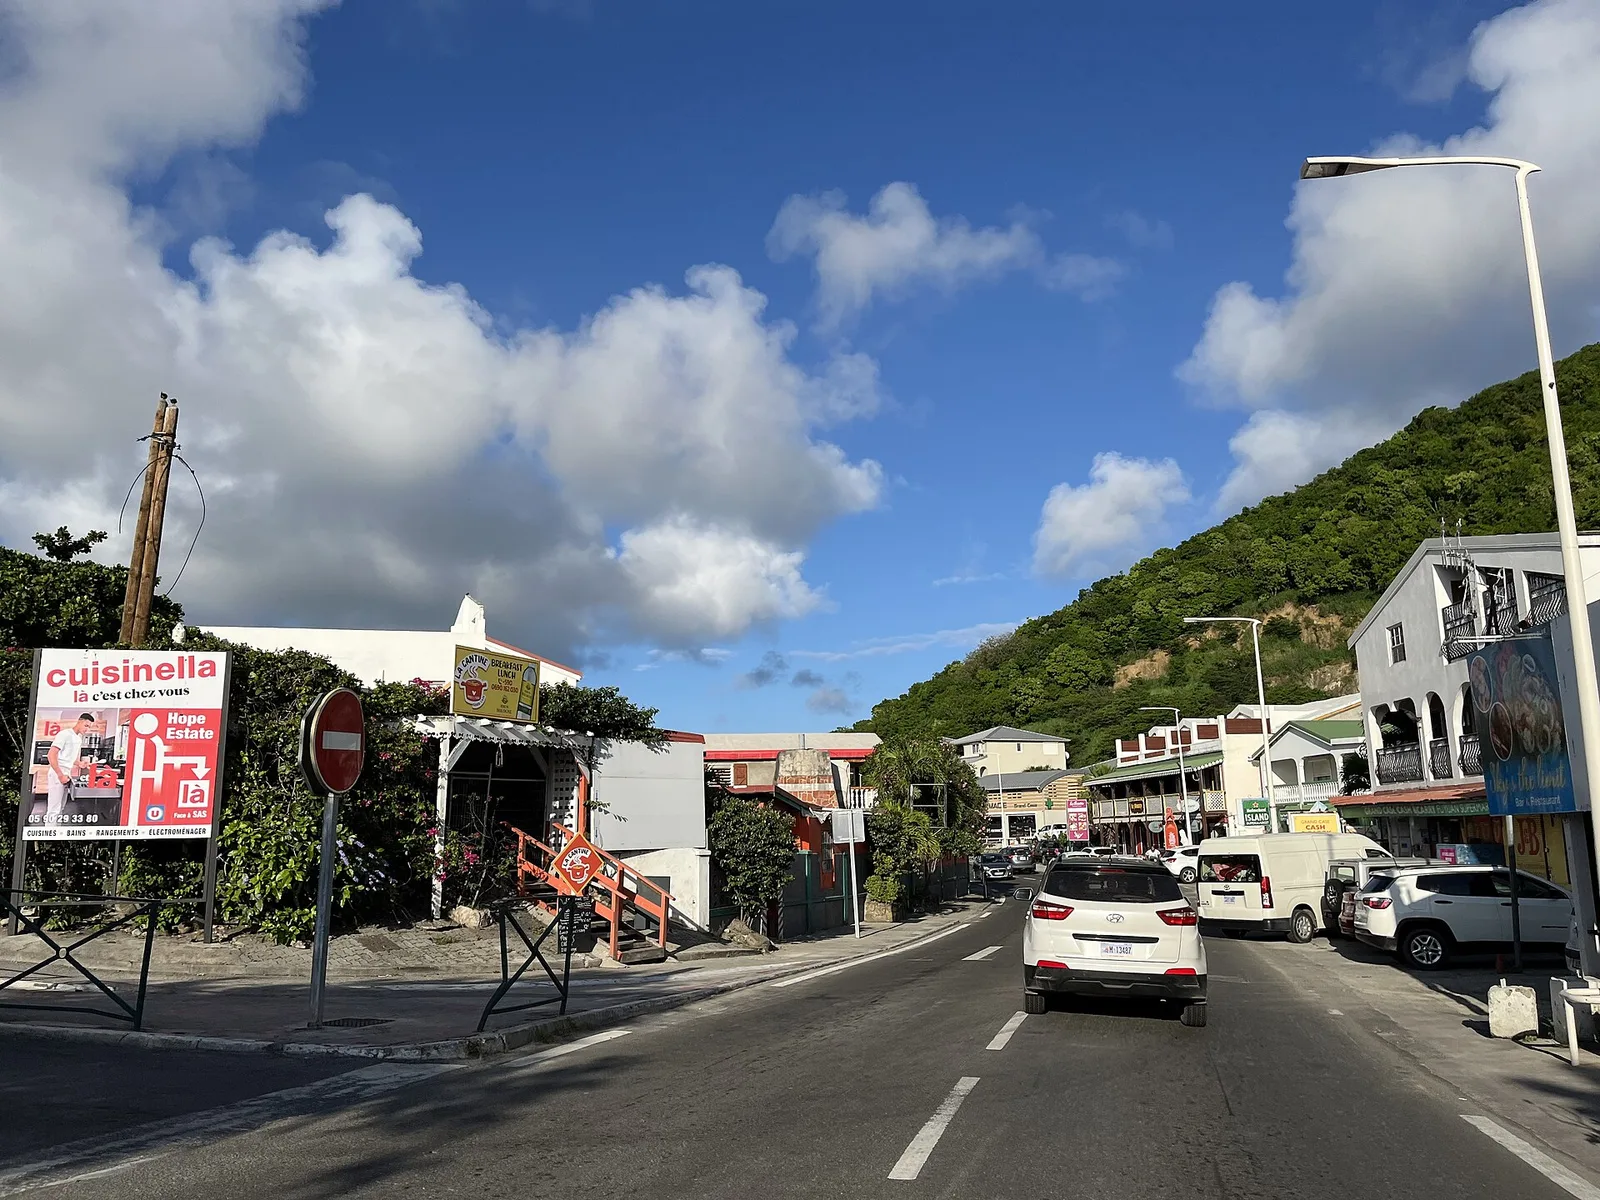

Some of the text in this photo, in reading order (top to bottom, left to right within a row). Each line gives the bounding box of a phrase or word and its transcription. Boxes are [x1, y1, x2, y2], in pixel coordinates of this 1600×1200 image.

[46, 655, 217, 688] cuisinella
[455, 654, 489, 680] LA CANTINE
[491, 658, 523, 672] BREAKFAST
[497, 669, 516, 680] LUNCH
[73, 687, 190, 703] là c'est chez vous
[167, 712, 206, 726] Hope
[44, 721, 61, 736] là
[166, 727, 214, 740] Estate
[1518, 756, 1535, 792] the
[1537, 754, 1566, 789] limit
[181, 782, 205, 804] là
[28, 814, 40, 823] 05
[57, 814, 69, 823] 29
[71, 814, 83, 823] 33
[86, 814, 98, 822] 80
[192, 810, 207, 818] SAS
[1244, 813, 1269, 822] ISLAND
[26, 829, 57, 837] CUISINES
[66, 829, 86, 837] BAINS
[562, 848, 589, 867] LA CANTINE
